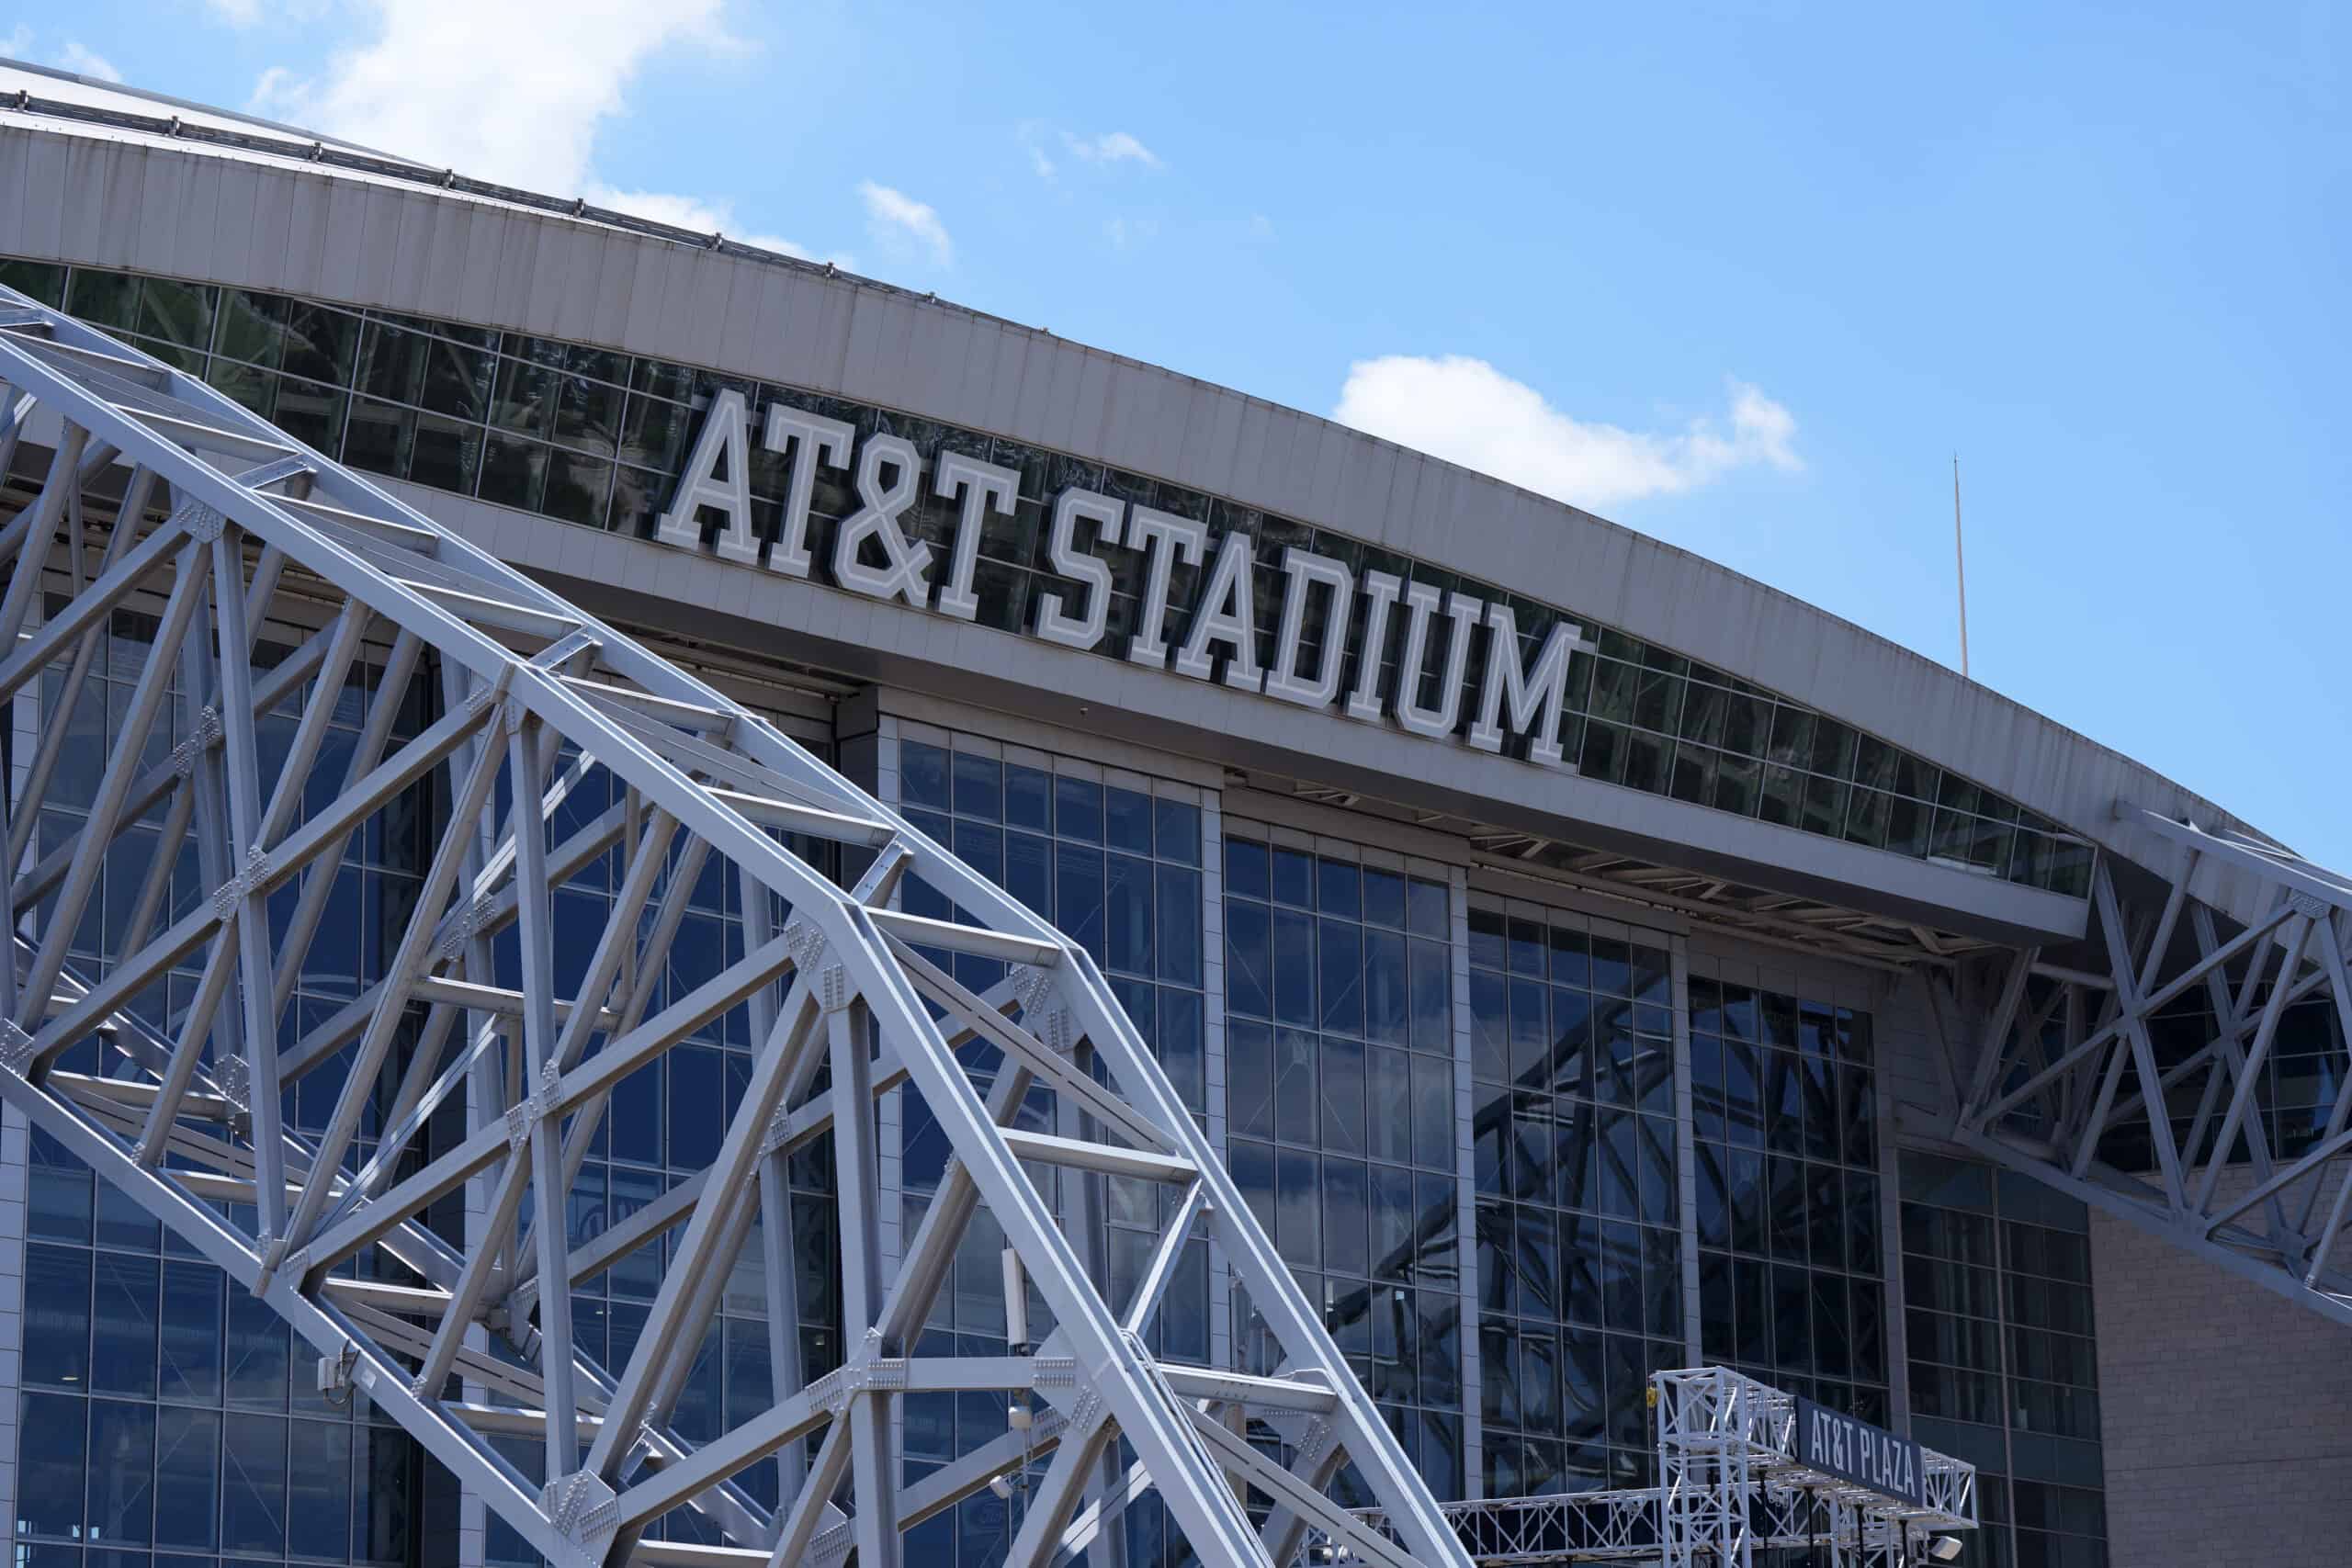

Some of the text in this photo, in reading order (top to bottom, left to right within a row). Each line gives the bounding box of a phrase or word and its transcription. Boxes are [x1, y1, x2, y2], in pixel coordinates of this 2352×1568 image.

[653, 388, 1583, 767] AT&T STADIUM
[1812, 1410, 1916, 1497] AT&T PLAZA
